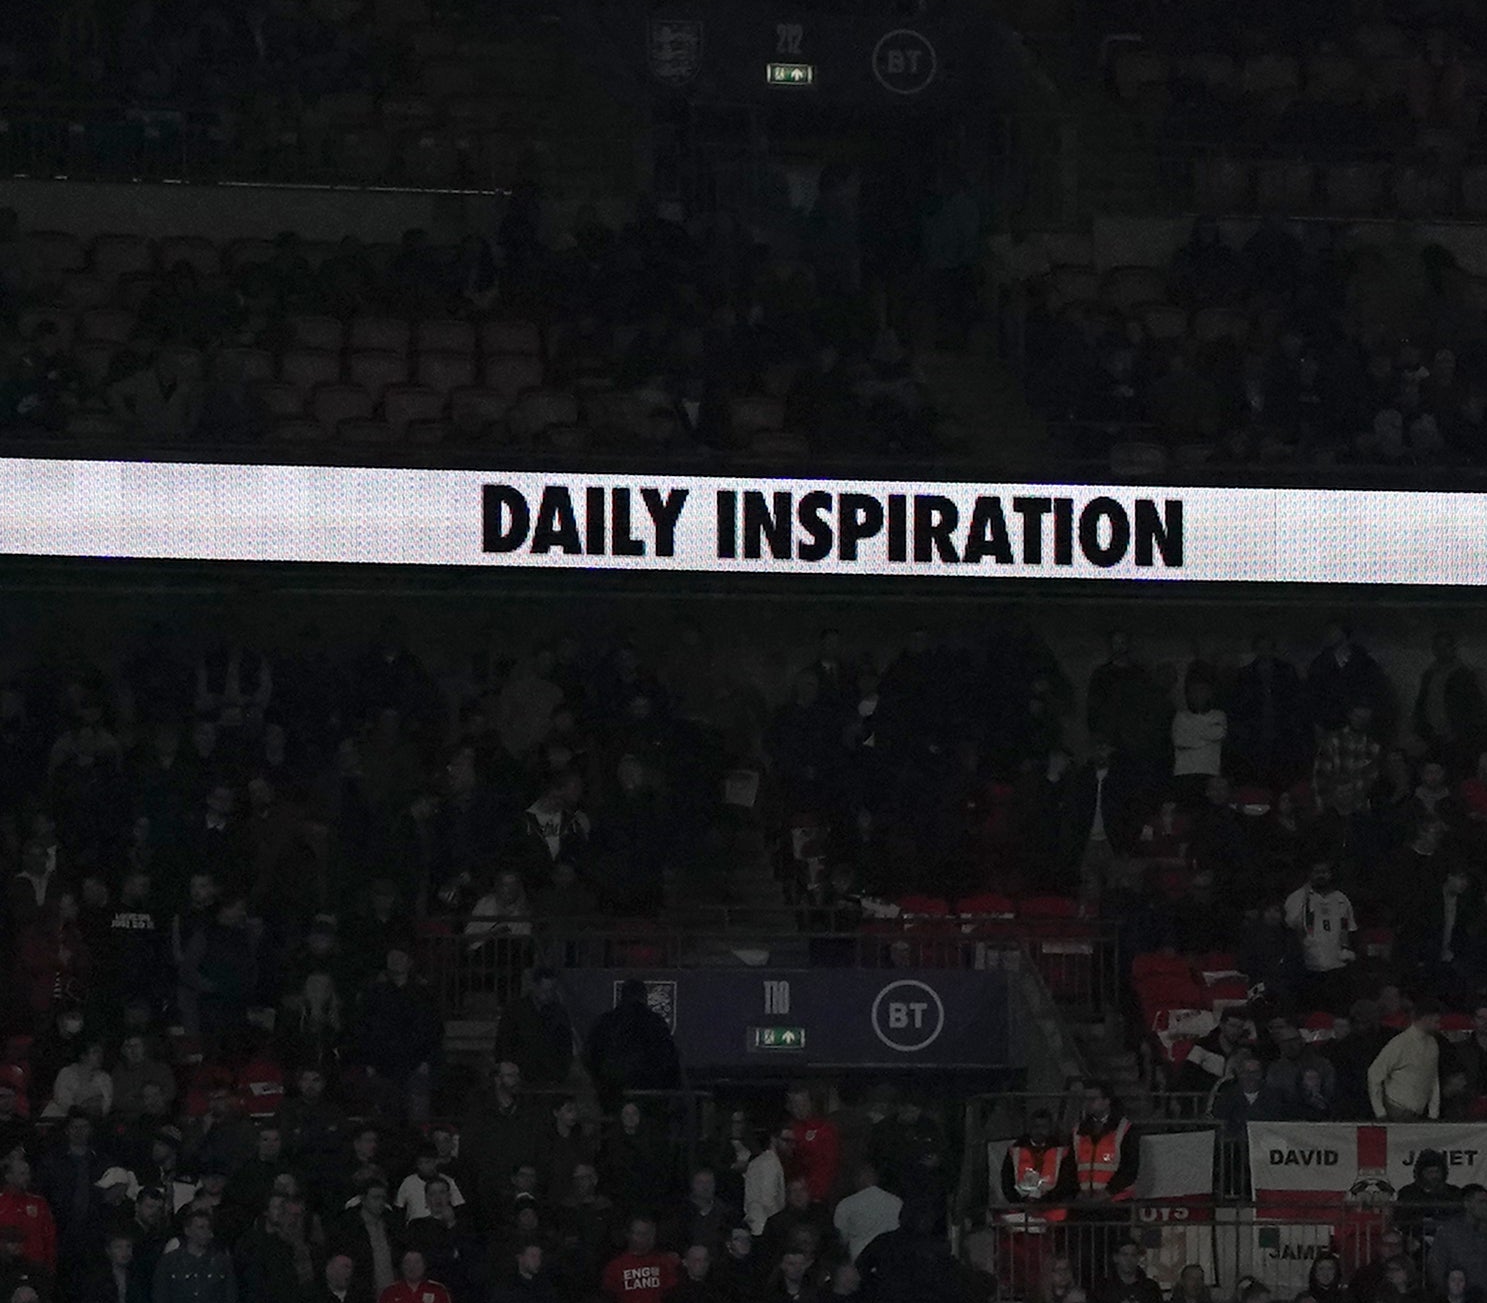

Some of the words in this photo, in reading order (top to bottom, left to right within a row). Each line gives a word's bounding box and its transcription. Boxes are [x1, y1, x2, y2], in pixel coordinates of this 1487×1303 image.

[887, 50, 922, 74] BT
[482, 483, 689, 558] DAILY
[717, 489, 1184, 569] INSPIRATION
[889, 1003, 929, 1028] BT
[1269, 1149, 1339, 1167] DAVID
[623, 1267, 651, 1279] ENG
[623, 1278, 660, 1291] LAND
